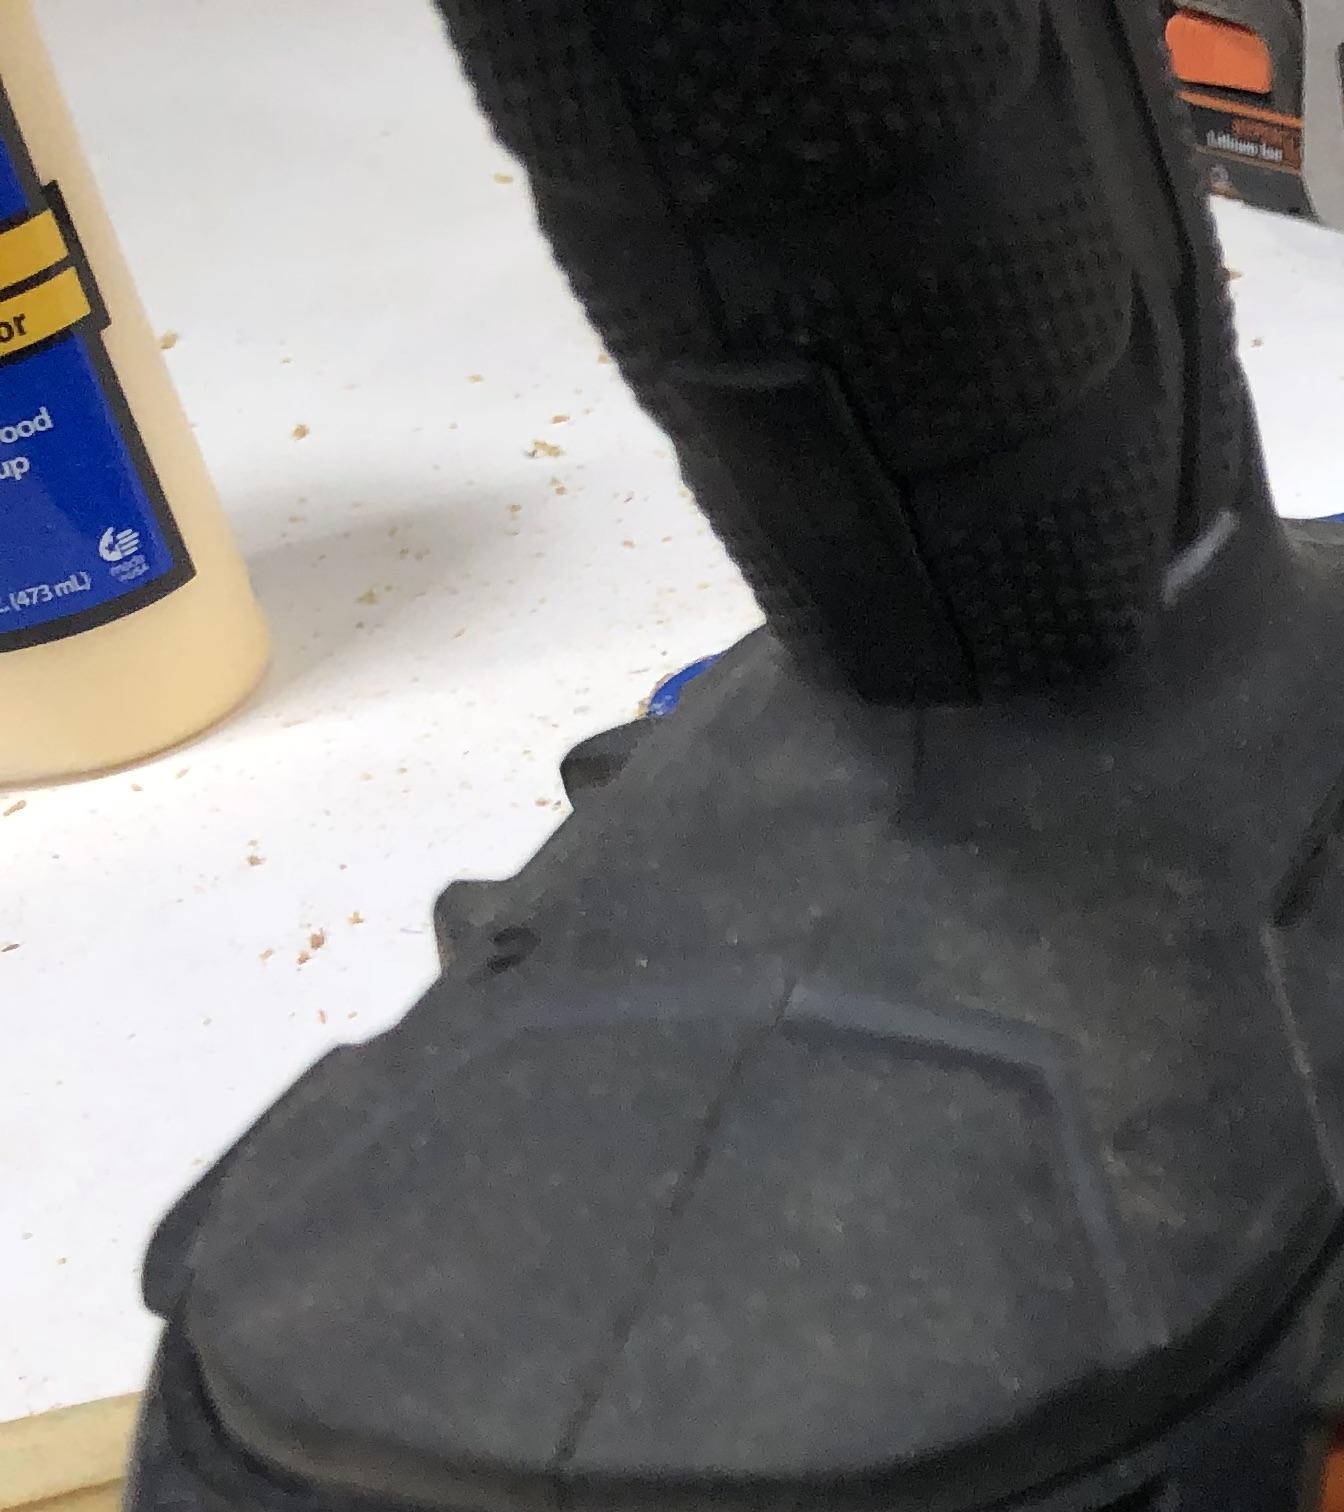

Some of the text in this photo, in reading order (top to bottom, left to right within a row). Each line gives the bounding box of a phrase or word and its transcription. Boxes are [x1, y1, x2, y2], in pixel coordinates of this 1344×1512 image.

[0, 313, 26, 343] or
[9, 571, 92, 611] (473 mL)
